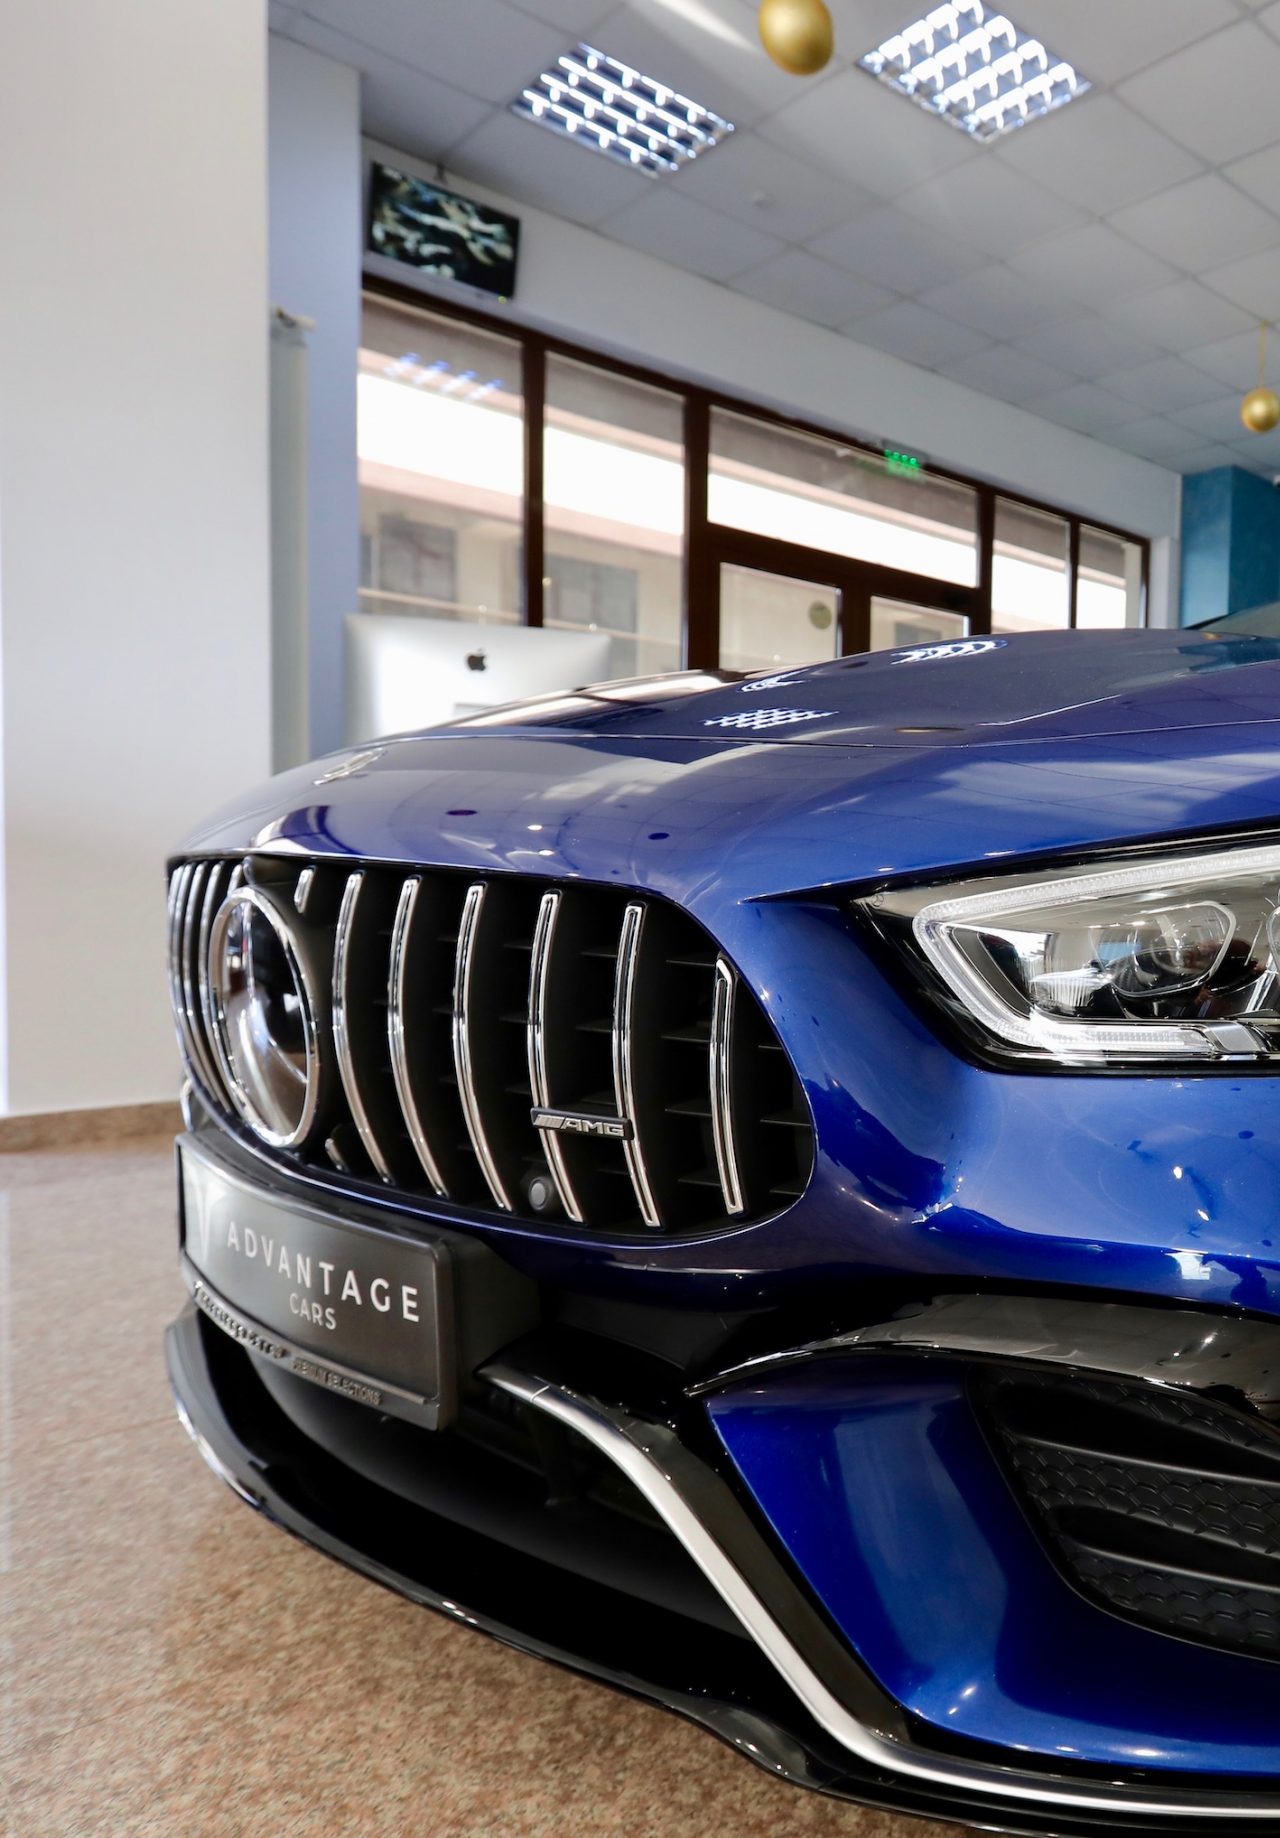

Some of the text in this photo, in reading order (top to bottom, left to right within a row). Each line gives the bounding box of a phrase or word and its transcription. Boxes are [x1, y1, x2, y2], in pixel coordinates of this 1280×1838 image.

[561, 1117, 625, 1137] AMG
[226, 1221, 420, 1323] ADVANTAGE
[289, 1292, 337, 1331] CARS
